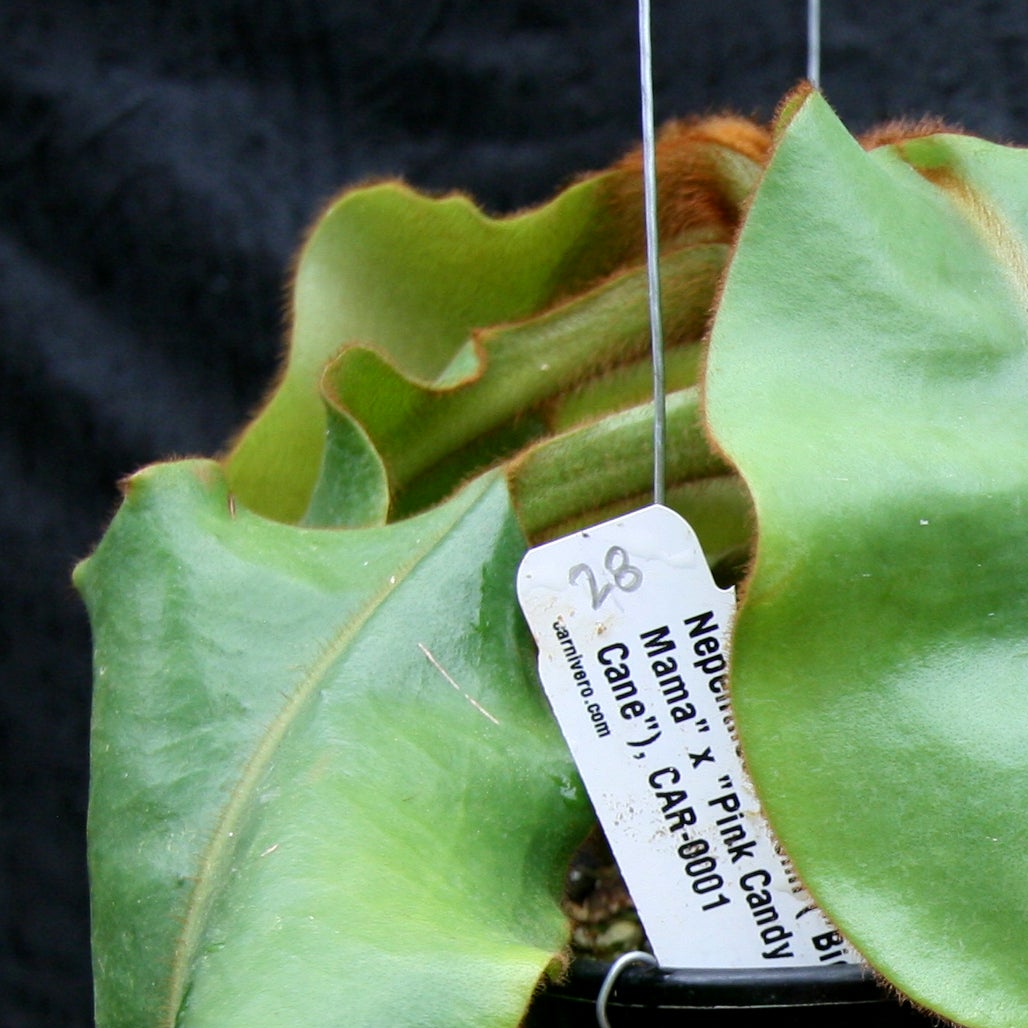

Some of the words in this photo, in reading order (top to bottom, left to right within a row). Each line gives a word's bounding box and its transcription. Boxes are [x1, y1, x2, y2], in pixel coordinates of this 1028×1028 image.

[568, 545, 643, 611] 28
[597, 642, 662, 760] Cane"),
[648, 766, 731, 912] CAR-0001
[639, 625, 710, 733] Mama"
[688, 746, 715, 769] x
[708, 774, 757, 864] "Pink
[739, 869, 794, 959] Candy
